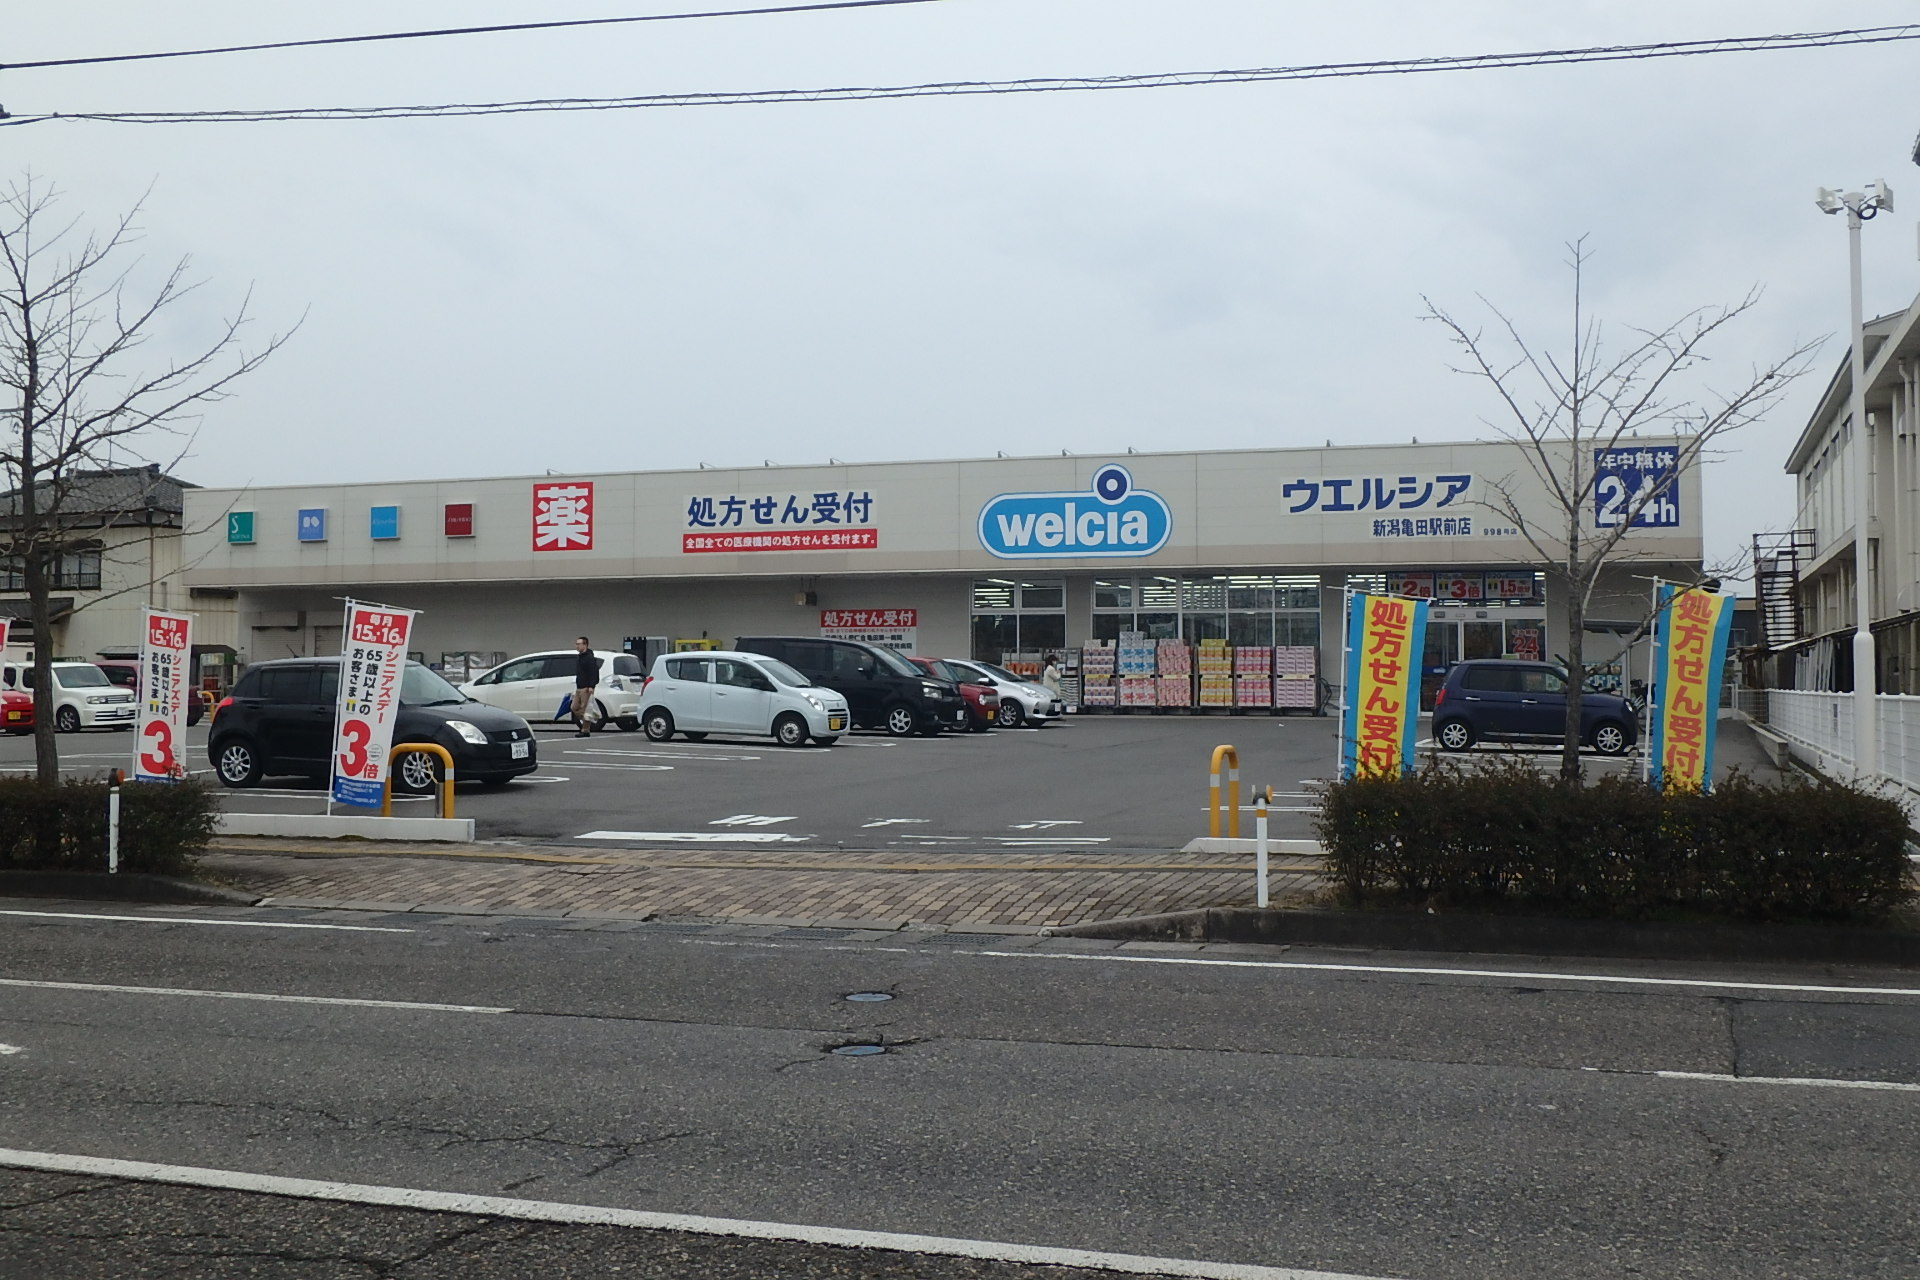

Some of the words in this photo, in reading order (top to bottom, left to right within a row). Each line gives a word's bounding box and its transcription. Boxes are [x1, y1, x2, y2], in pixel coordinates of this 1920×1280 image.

[1598, 452, 1675, 470] 年中無休
[535, 486, 590, 548] 薬
[687, 491, 873, 527] 処方せん受付
[1282, 474, 1472, 513] ウエルシア
[1598, 475, 1676, 524] 24h
[997, 502, 1149, 547] welcia
[1373, 517, 1471, 537] 新潟亀田駅前店
[160, 619, 177, 632] 毎月
[370, 613, 393, 628] 毎月
[824, 610, 914, 627] 処方せん受付
[160, 653, 172, 718] 65歳以上の
[348, 647, 364, 697] お客さま
[359, 649, 383, 716] 65歳以上の
[376, 650, 399, 724] シニアズデー
[1361, 599, 1408, 771] 処方せん受付
[1666, 591, 1714, 780] 処方せん受付
